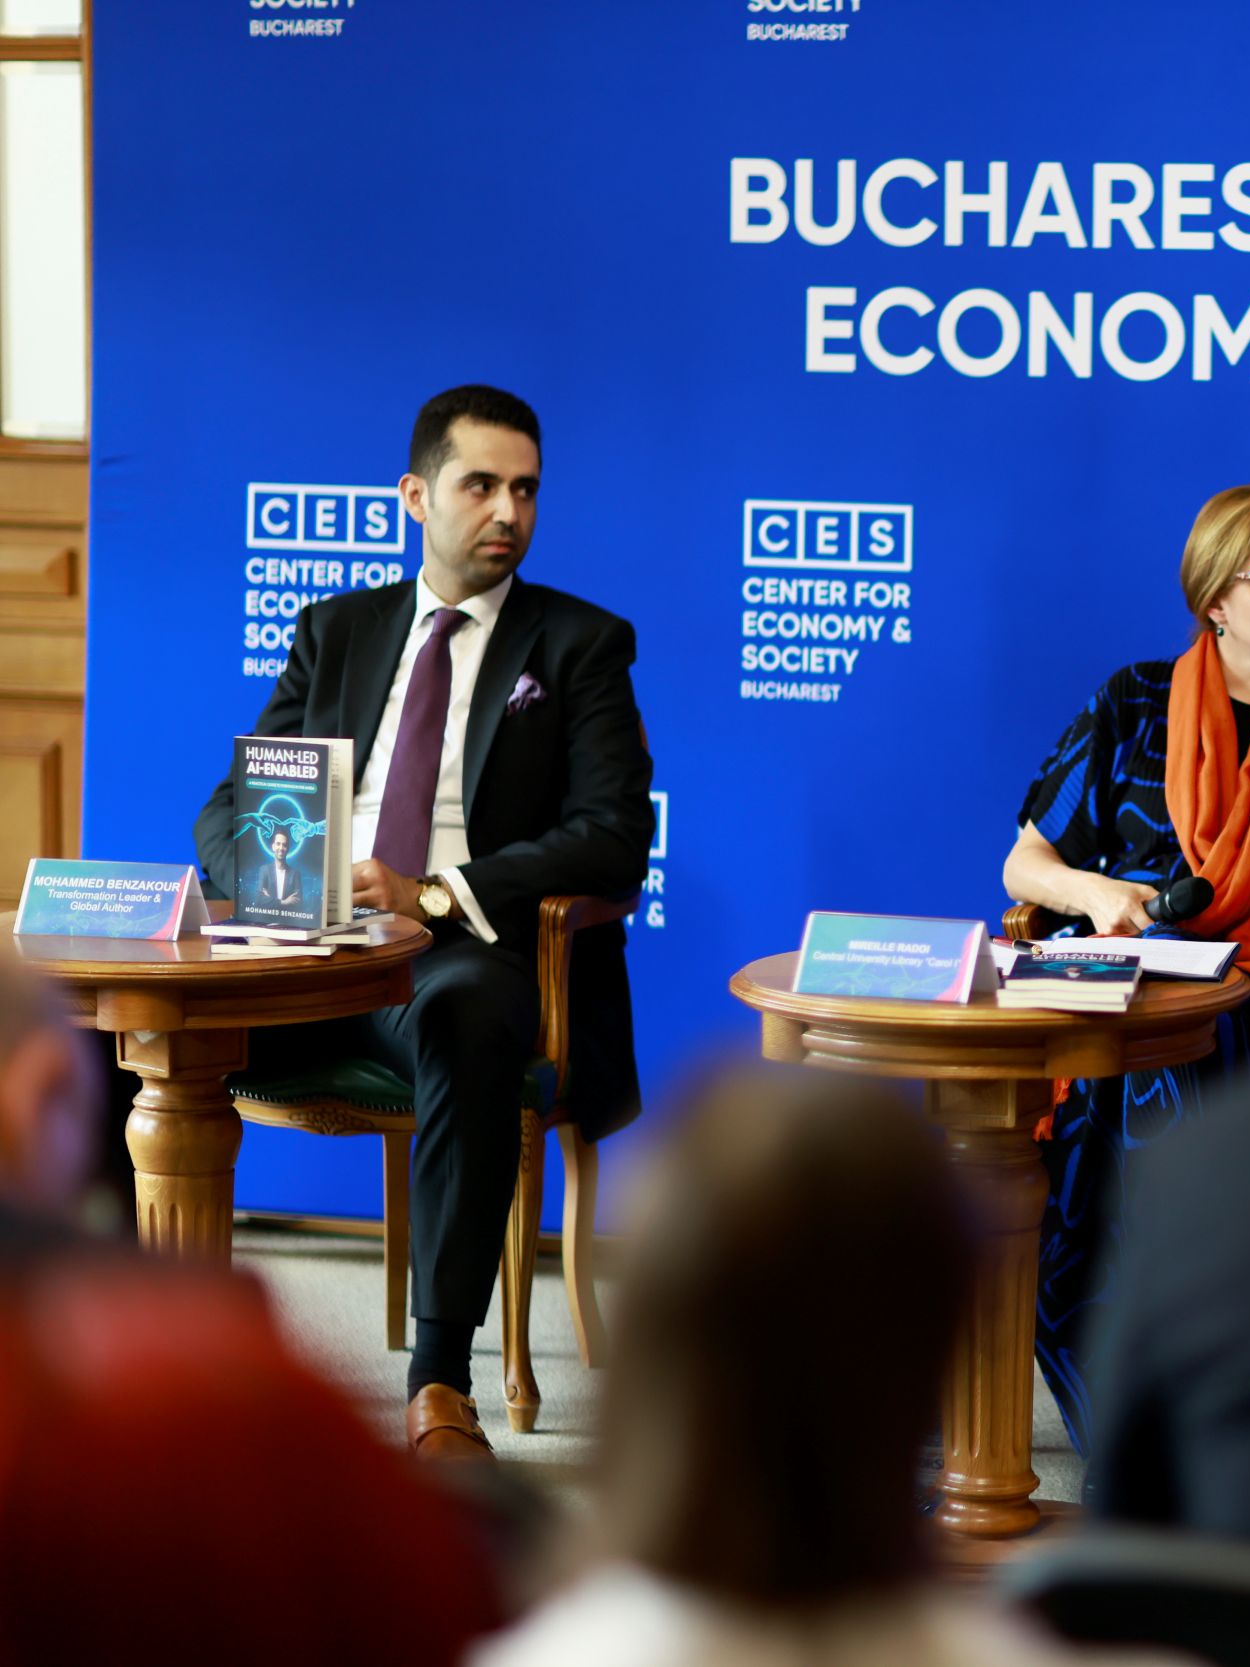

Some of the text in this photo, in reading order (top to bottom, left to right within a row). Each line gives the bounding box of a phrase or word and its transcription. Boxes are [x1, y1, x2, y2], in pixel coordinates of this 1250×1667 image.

[250, 19, 344, 36] BUCHAREST
[747, 24, 849, 40] BUCHAREST
[261, 497, 389, 539] CES
[758, 515, 894, 556] CES
[246, 557, 344, 587] CENTER
[743, 578, 910, 608] CENTER FOR
[743, 611, 911, 642] ECONOMY &
[742, 645, 858, 673] SOCIETY
[741, 681, 841, 701] BUCHAREST
[246, 746, 319, 764] HUMAN-LED
[246, 761, 319, 779] AI-ENABLED
[34, 876, 181, 892] MOHAMMED BENZAKOUR
[48, 889, 161, 903] Transformation Leader &
[70, 901, 134, 913] Global Author
[245, 907, 280, 916] MOHAMMED
